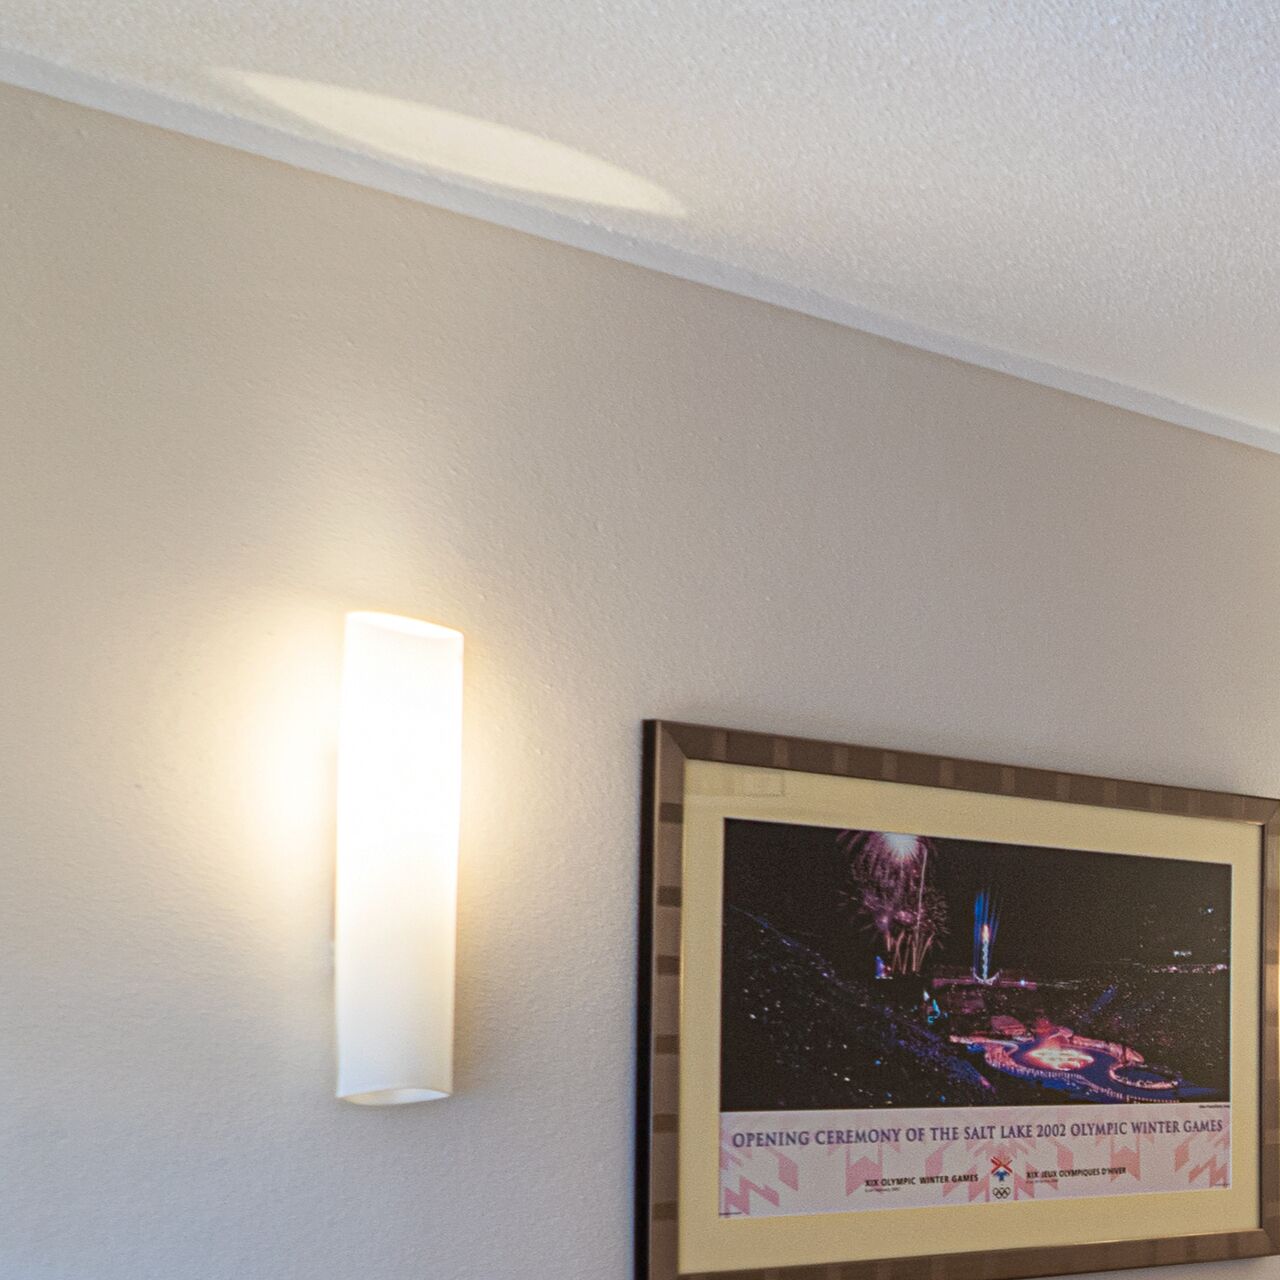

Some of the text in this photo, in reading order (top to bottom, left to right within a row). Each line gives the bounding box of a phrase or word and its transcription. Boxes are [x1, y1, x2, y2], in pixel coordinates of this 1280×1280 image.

[732, 1119, 1223, 1148] OPENING CEREMONY OF THE SALT LAKE 2002 OLYMPIC WINTER GAMES
[881, 1177, 916, 1187] OLYMPIC
[919, 1175, 949, 1185] WINTER
[951, 1173, 979, 1183] GAMES
[1041, 1170, 1057, 1179] JEUX
[1059, 1168, 1100, 1178] OLYMPIQUES
